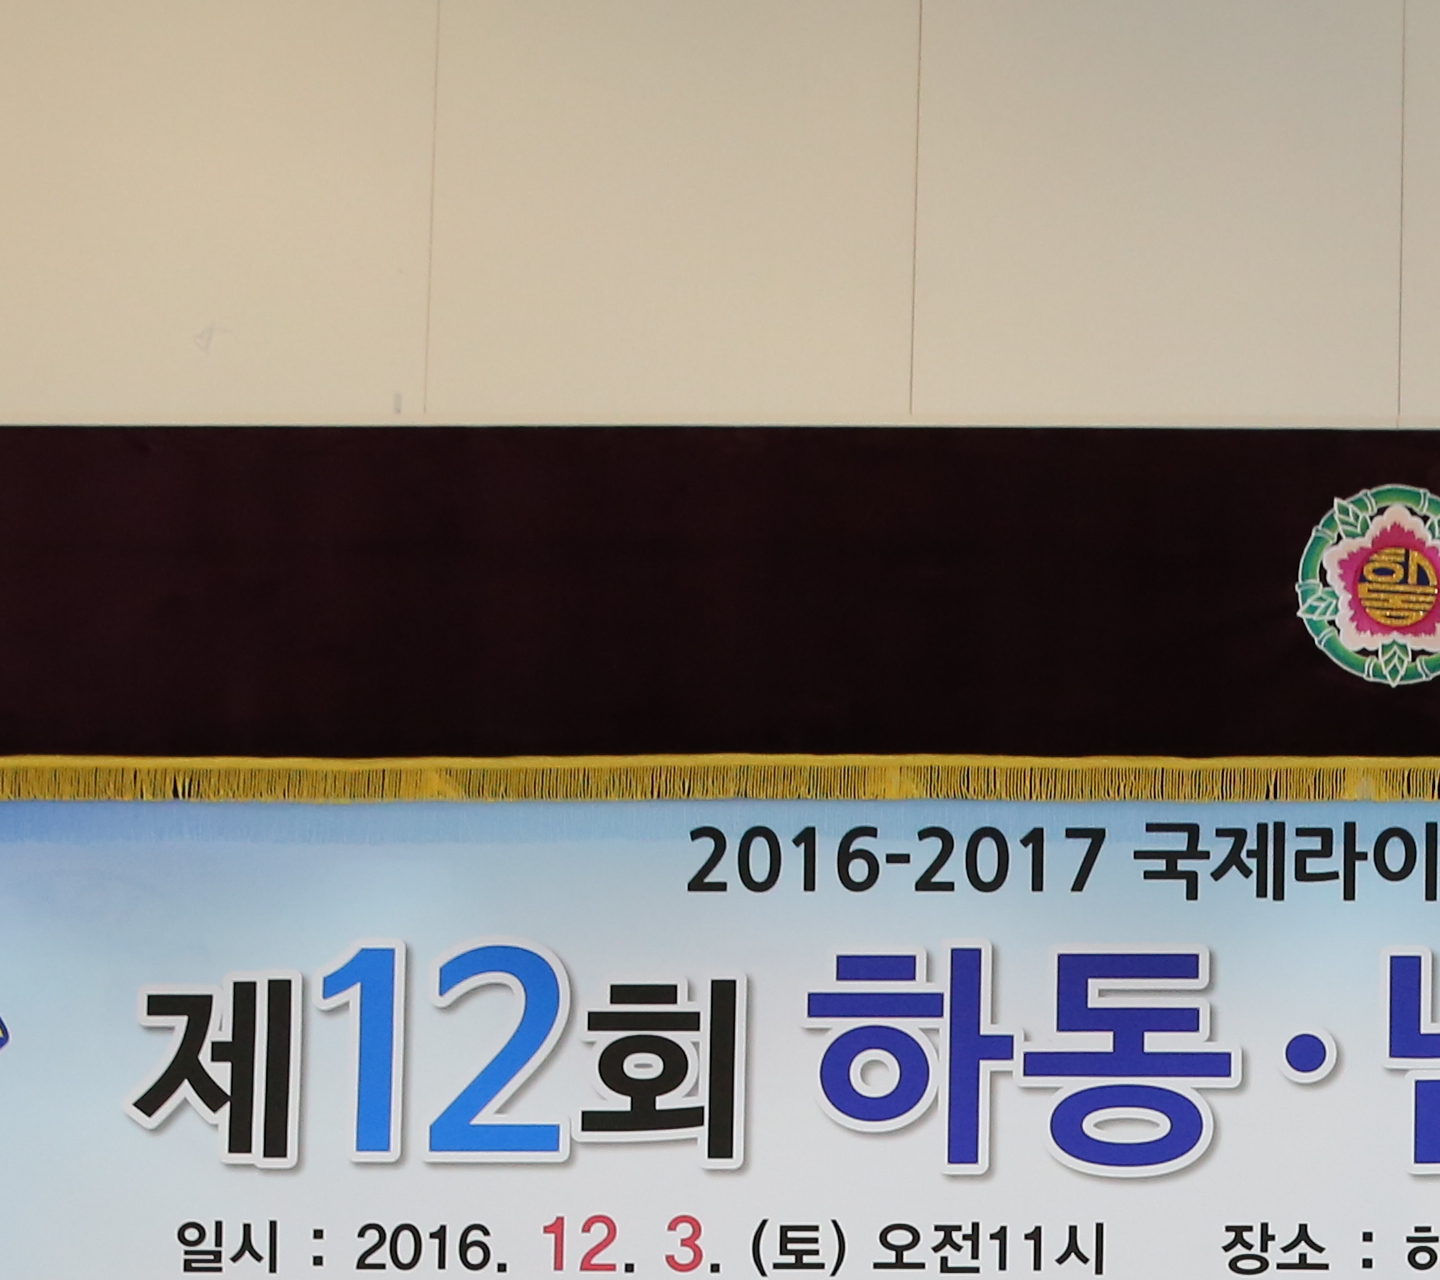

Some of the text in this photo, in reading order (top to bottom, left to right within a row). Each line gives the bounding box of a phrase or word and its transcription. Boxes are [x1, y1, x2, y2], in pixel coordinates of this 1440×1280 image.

[686, 826, 1107, 894] 2016-2017
[132, 944, 738, 1159] 제12회
[176, 1219, 280, 1274] 일시
[356, 1221, 508, 1273] 2016.
[542, 1213, 635, 1273] 12.
[664, 1213, 722, 1274] 3.
[749, 1218, 846, 1278] (토)
[872, 1221, 1106, 1276] 오전11시
[1221, 1221, 1330, 1276] 장소
